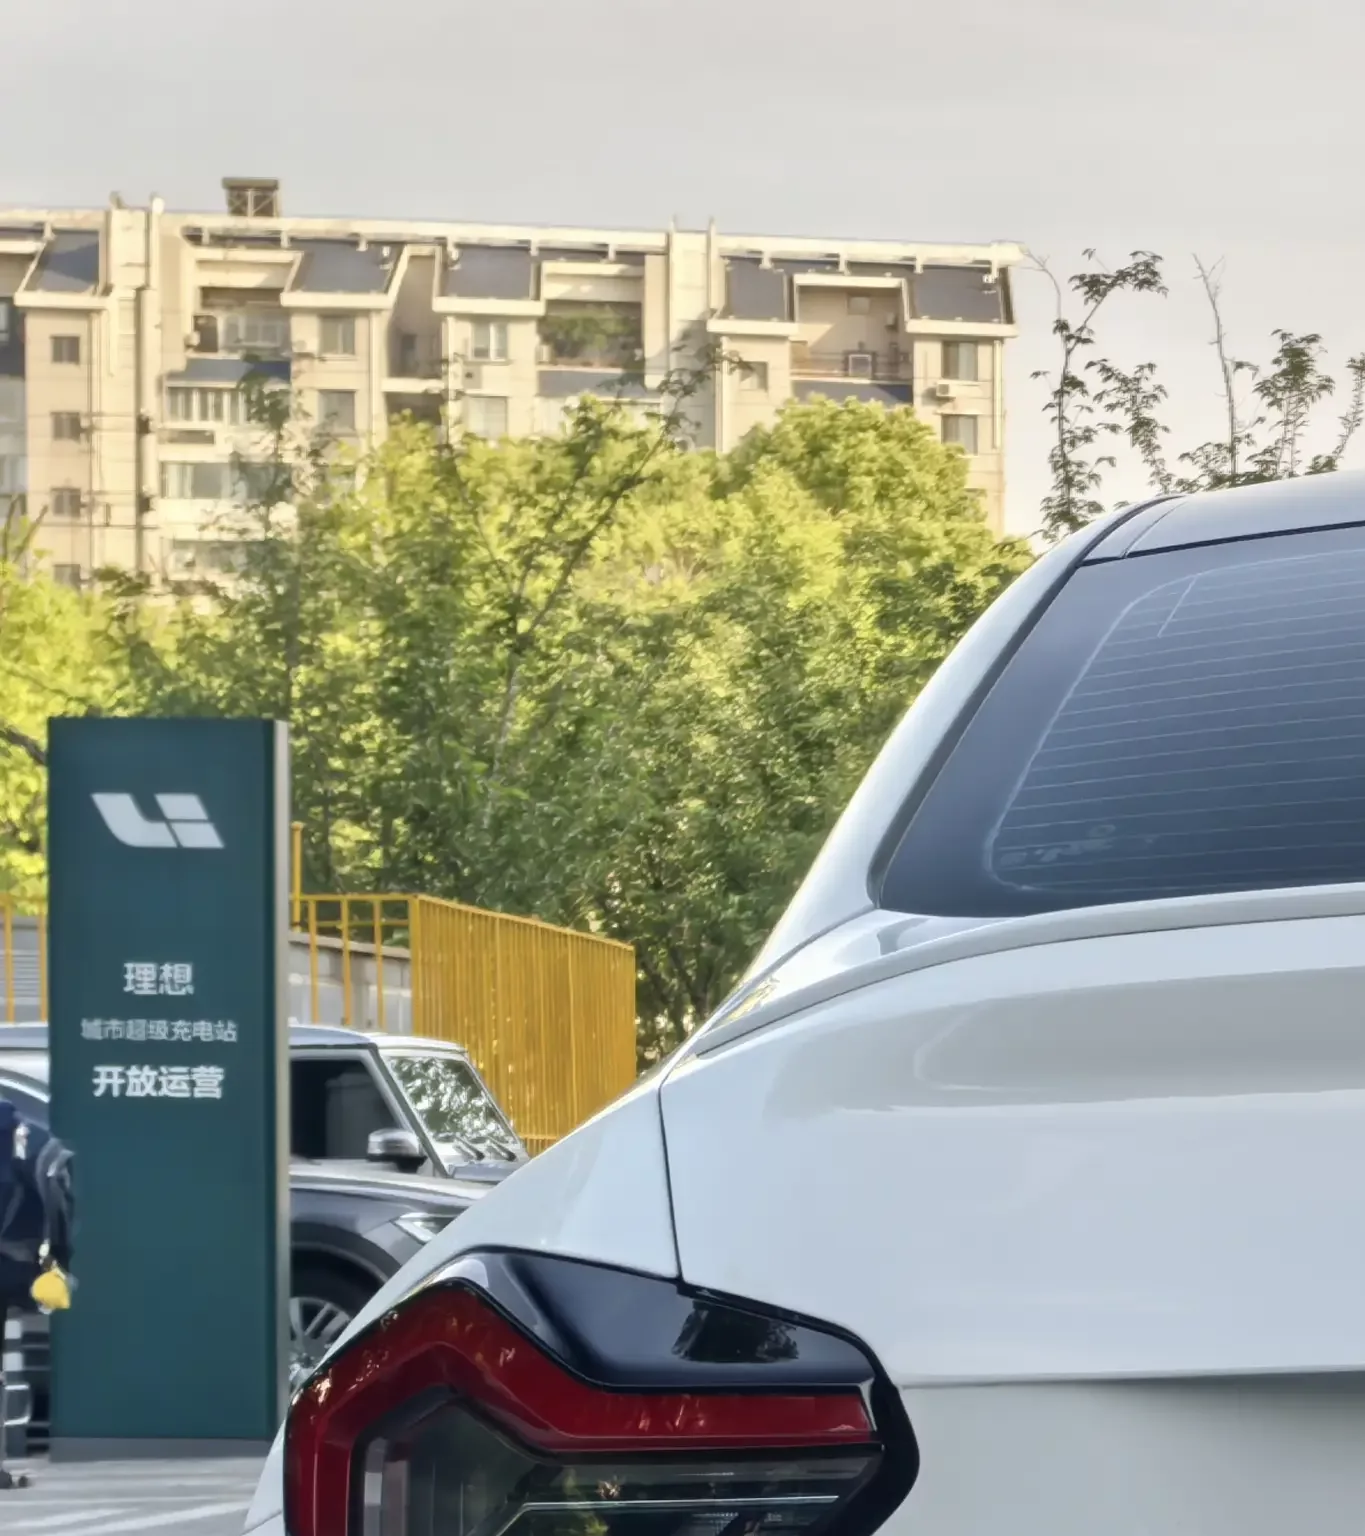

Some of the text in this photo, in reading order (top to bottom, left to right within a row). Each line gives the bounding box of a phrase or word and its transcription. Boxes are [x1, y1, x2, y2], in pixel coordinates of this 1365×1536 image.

[123, 962, 195, 996] 理想
[92, 1064, 225, 1099] 开放运营
